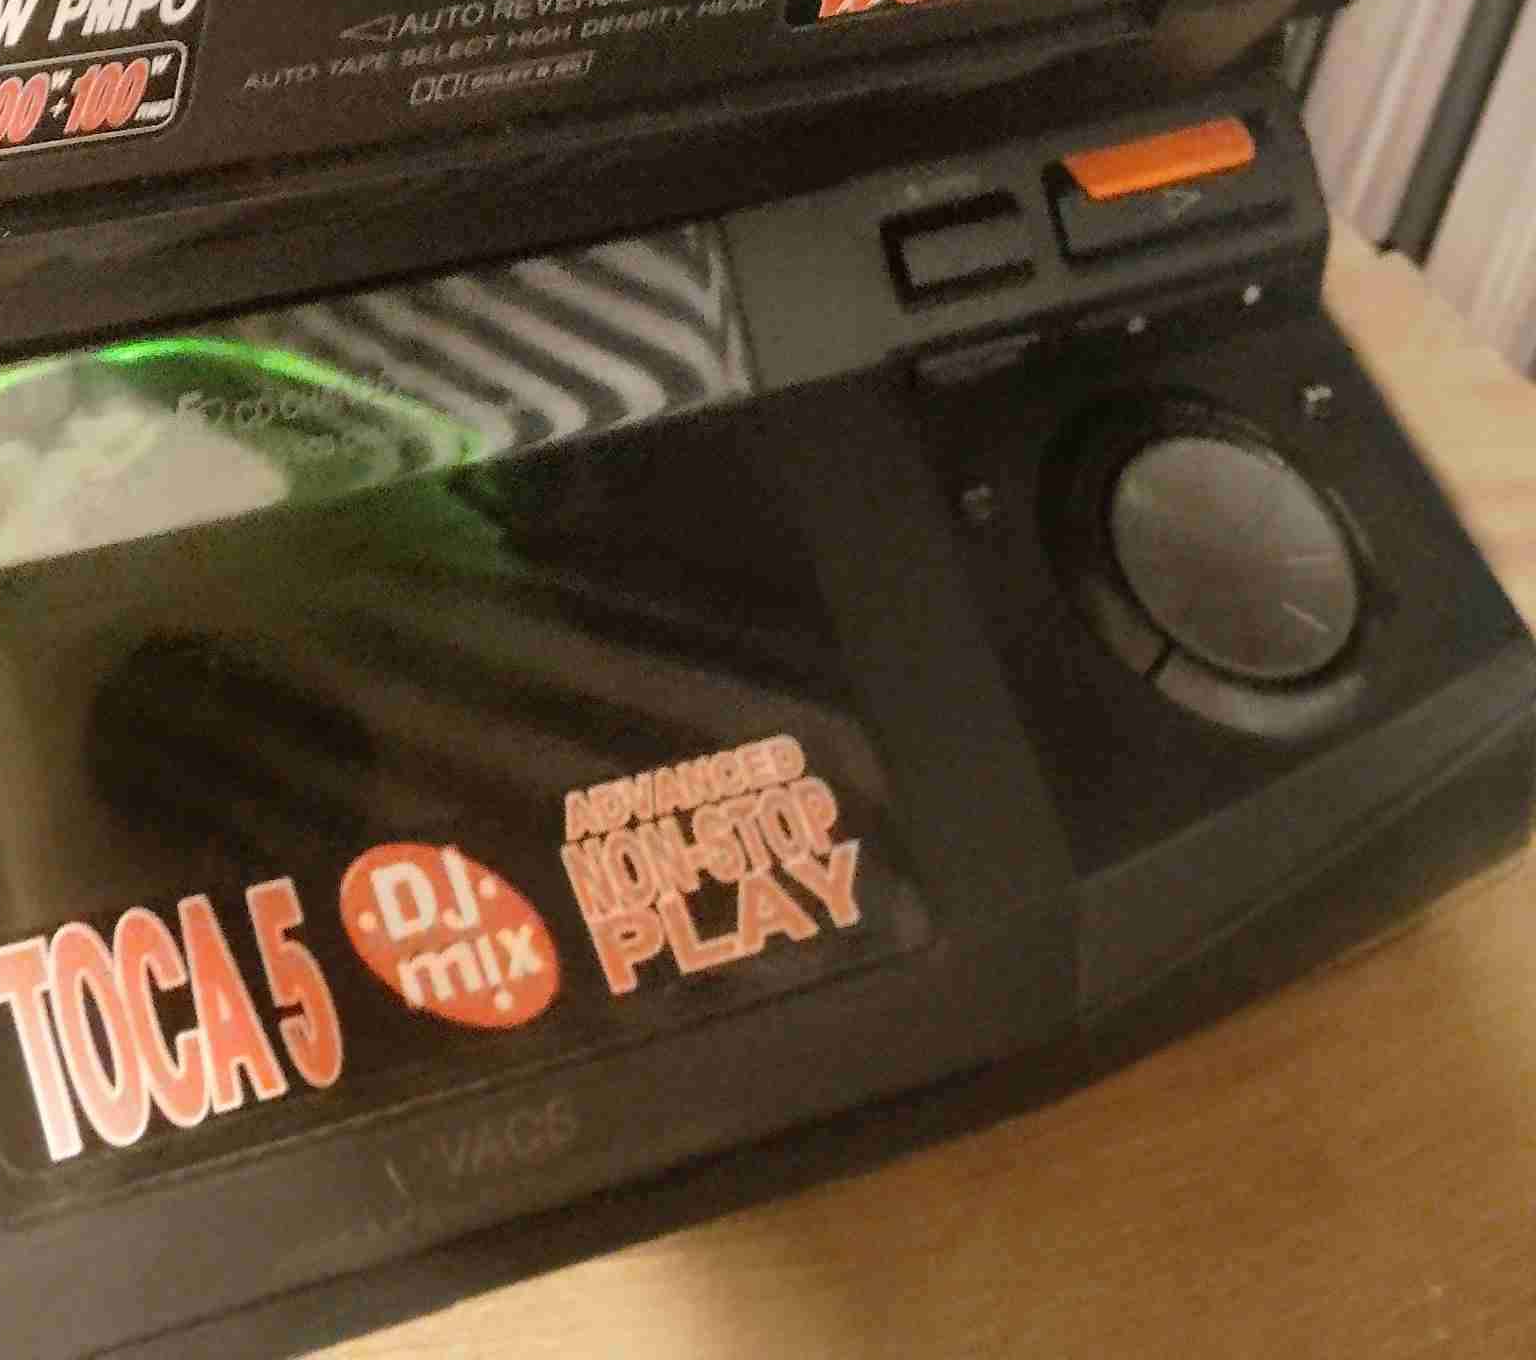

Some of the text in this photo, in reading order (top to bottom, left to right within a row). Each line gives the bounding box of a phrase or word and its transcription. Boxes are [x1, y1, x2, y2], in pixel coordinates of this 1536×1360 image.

[244, 63, 318, 89] AUTO
[330, 51, 393, 75] TAPE
[399, 35, 496, 65] SELECT
[508, 23, 571, 48] HIGH
[580, 4, 688, 39] DENSITY
[398, 0, 485, 36] AUTO
[564, 733, 806, 841] ADVANCED
[370, 843, 481, 943] DJ
[561, 776, 837, 920] NON-STOP
[397, 923, 545, 1009] mix
[587, 839, 861, 995] PLAY
[246, 876, 344, 1088] 5
